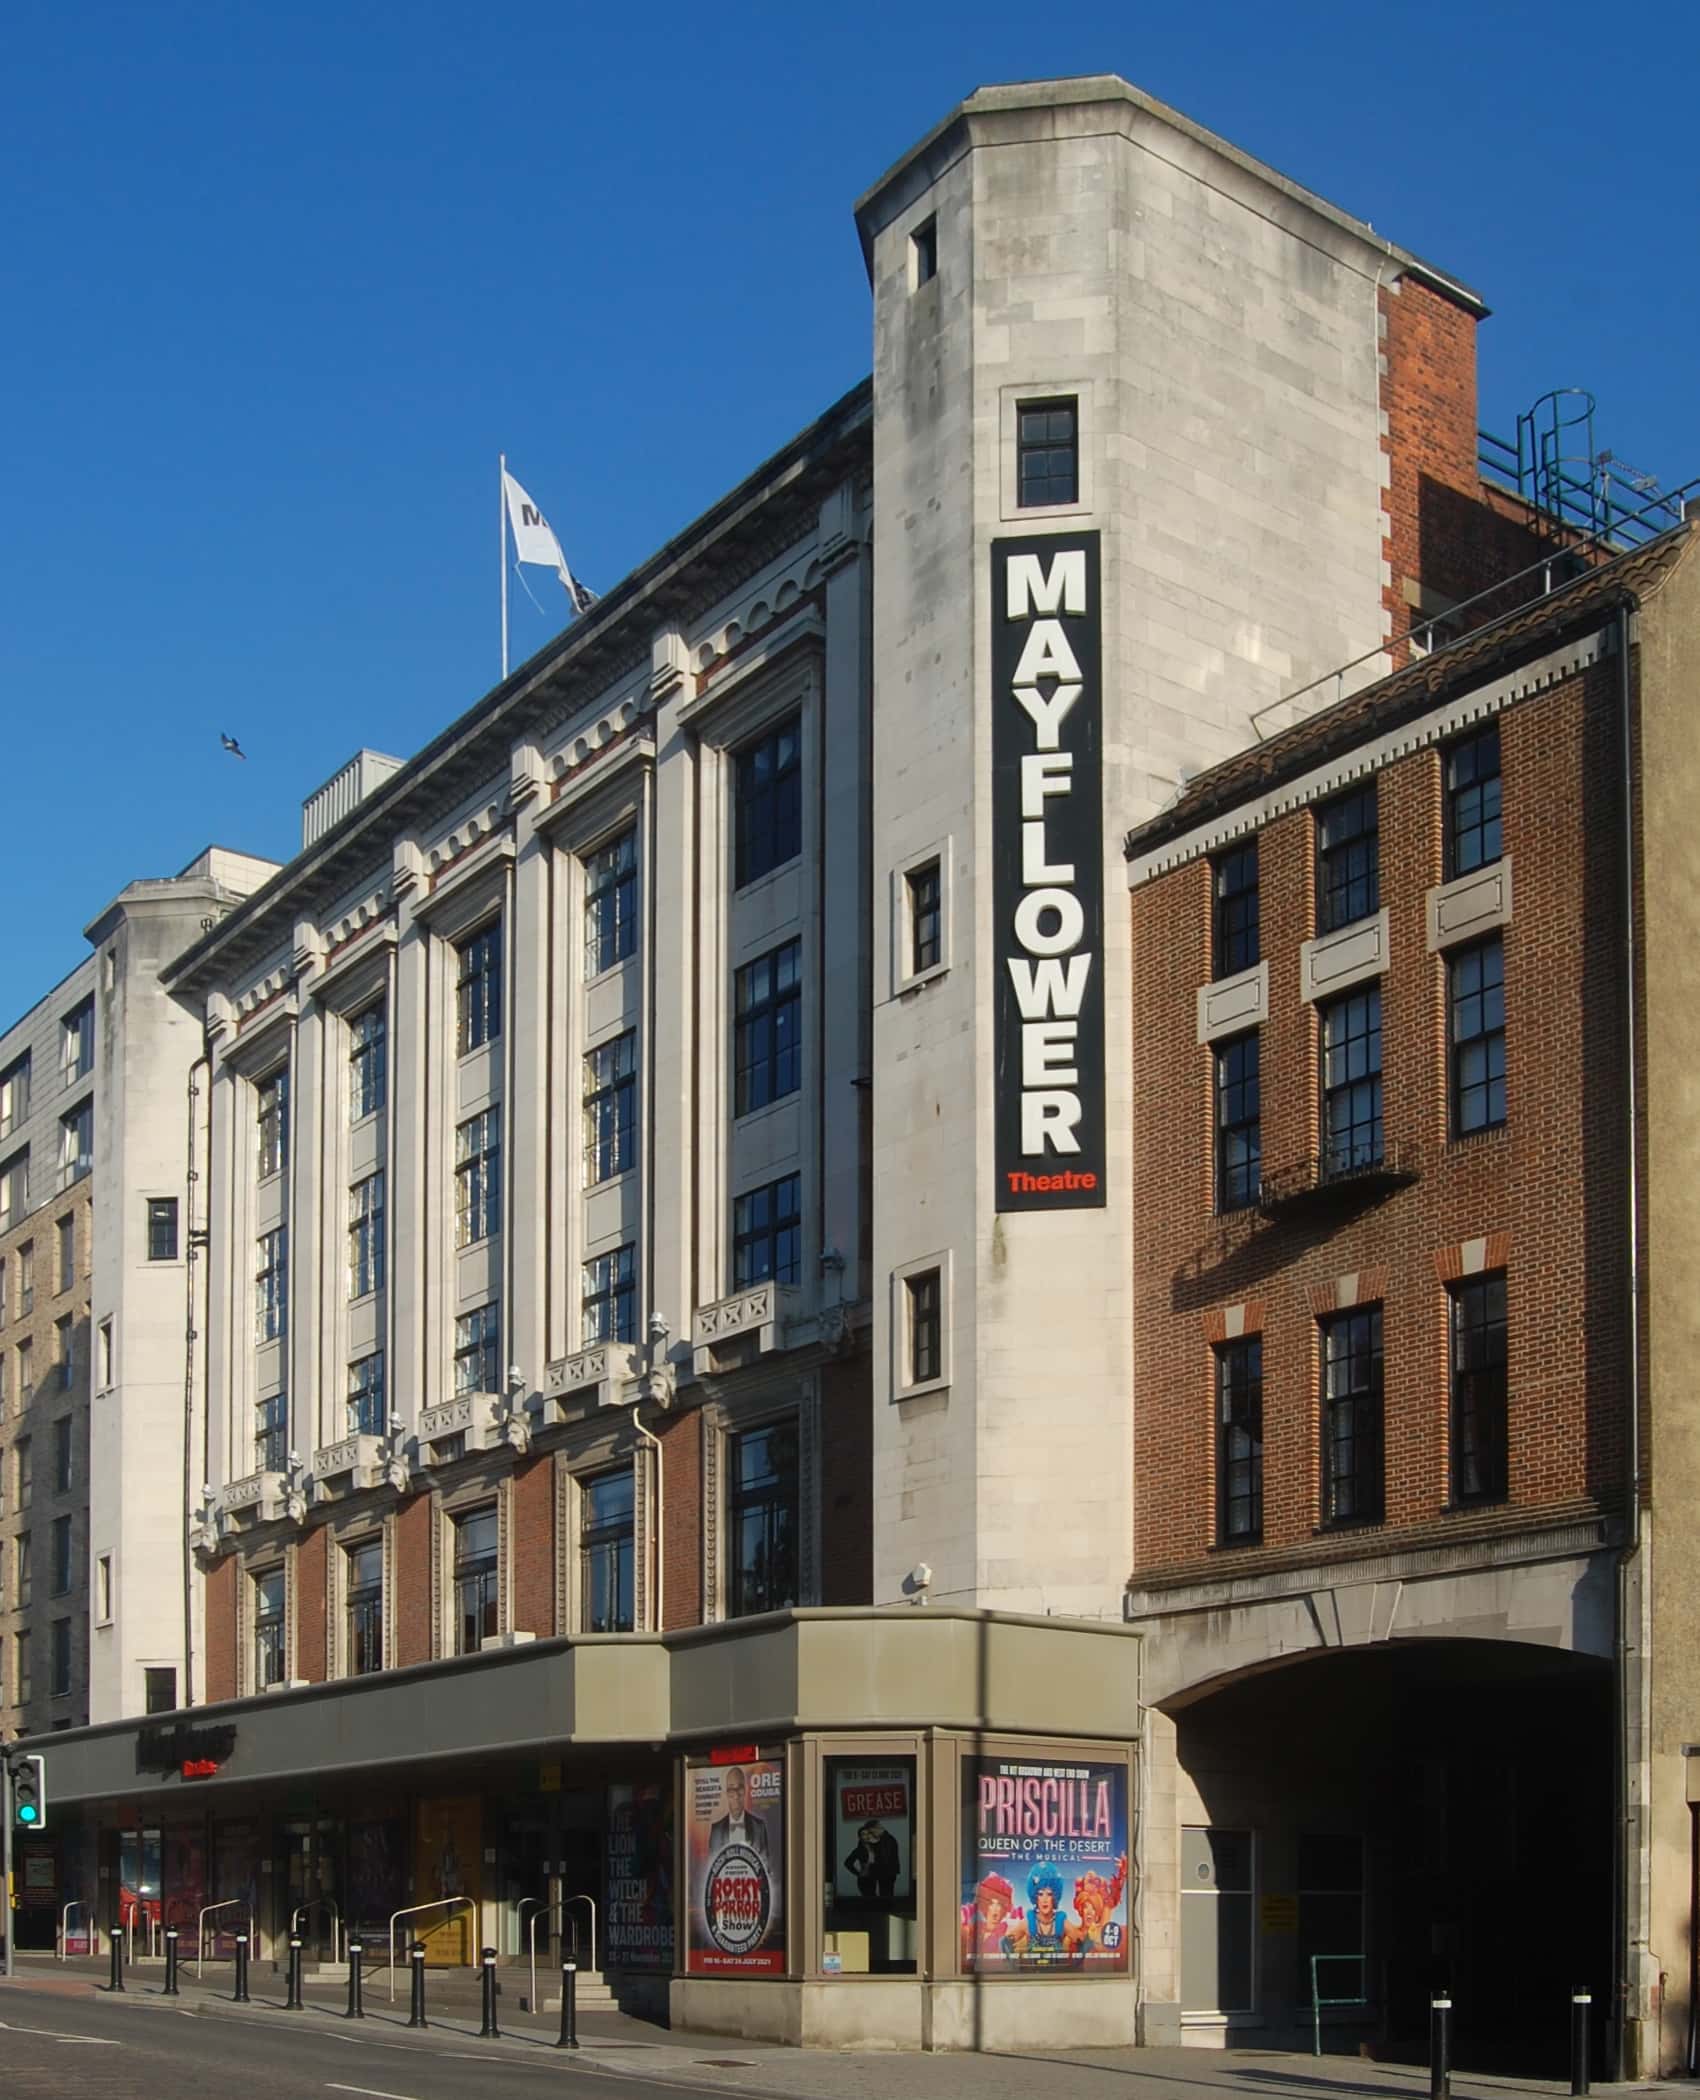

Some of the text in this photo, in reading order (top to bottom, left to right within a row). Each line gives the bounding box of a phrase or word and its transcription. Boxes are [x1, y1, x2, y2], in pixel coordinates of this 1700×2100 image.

[1005, 548, 1093, 1158] MAYFLOWER
[1007, 1169, 1097, 1193] Theatre
[750, 1772, 781, 1788] ORE
[847, 1791, 903, 1812] GREASE
[978, 1775, 1112, 1838] PRISCILLA
[608, 1832, 637, 1856] LION
[979, 1838, 1112, 1853] QUEEN OF THE DESERT
[608, 1856, 632, 1878] THE
[1011, 1852, 1082, 1862] THE MUSICAL
[608, 1879, 648, 1900] WITCH
[711, 1876, 762, 1901] ROCKY
[608, 1902, 645, 1923] & THE
[608, 1925, 676, 1946] WARDROBE
[722, 1920, 754, 1930] Show
